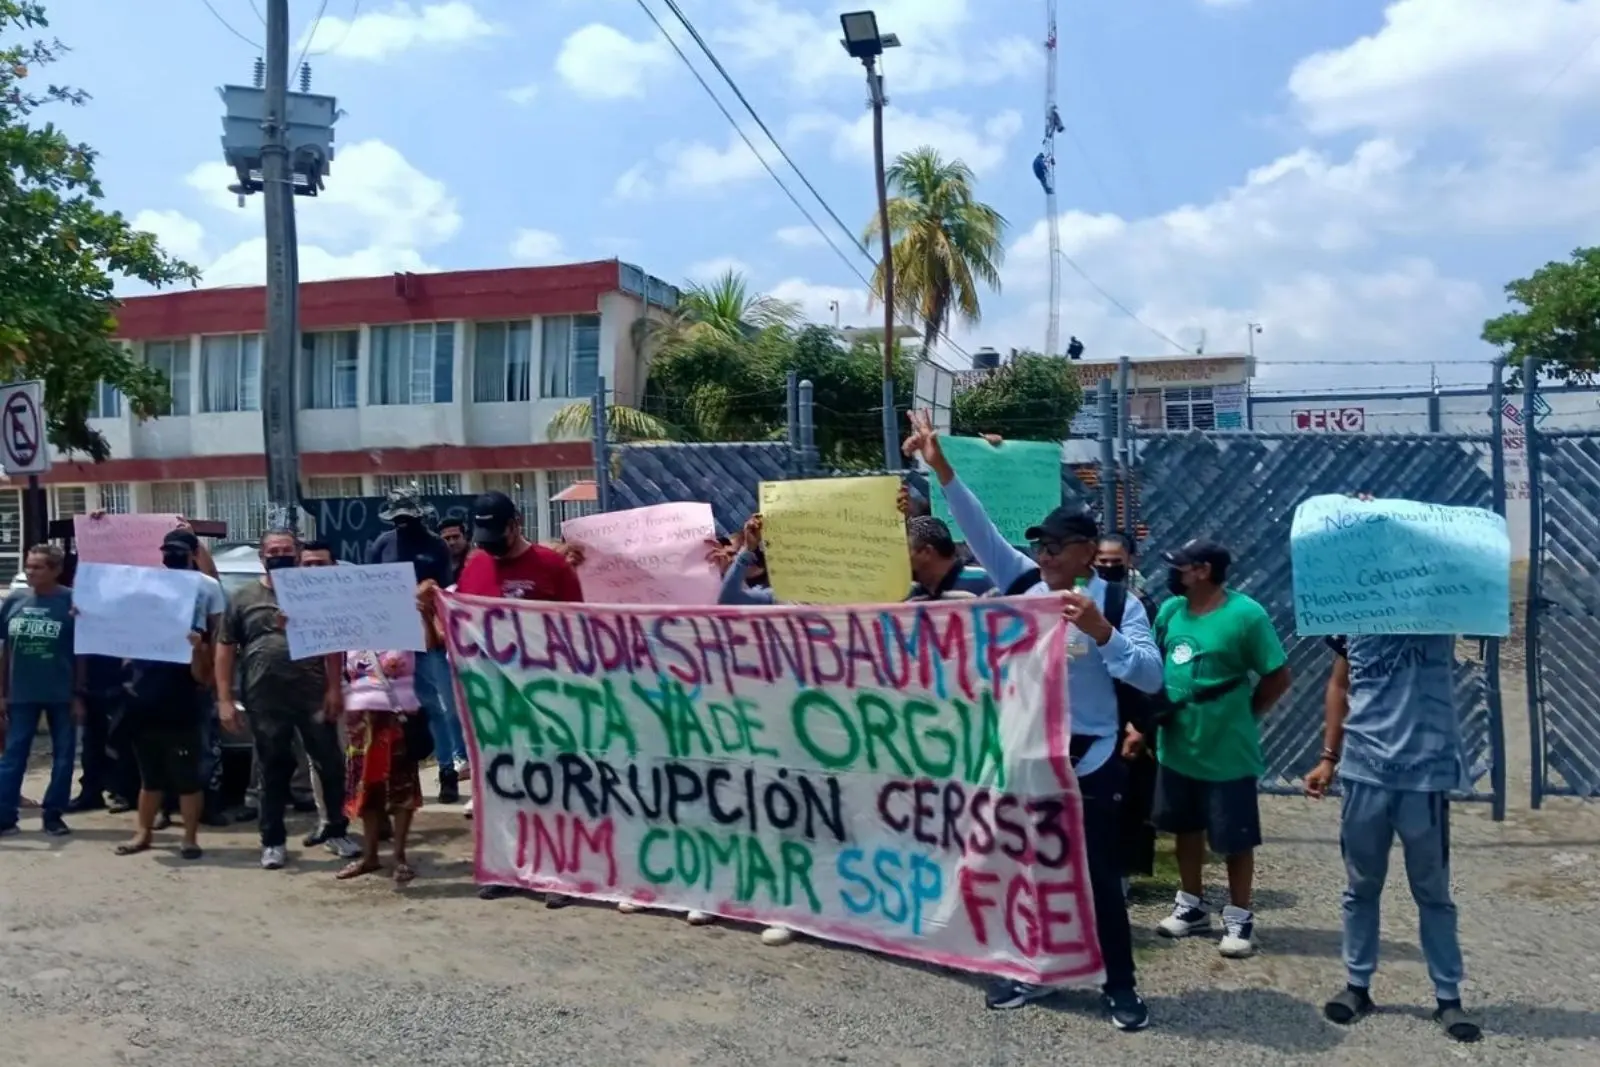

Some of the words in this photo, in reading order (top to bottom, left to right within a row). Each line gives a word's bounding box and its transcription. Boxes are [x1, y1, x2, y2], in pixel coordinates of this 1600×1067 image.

[319, 499, 368, 537] NO
[462, 668, 638, 759] BASTA
[629, 675, 719, 757] YA
[708, 695, 780, 759] DE
[791, 688, 1006, 791] ORGIA
[485, 752, 846, 843] CORRUPCIÓN
[515, 810, 618, 888] INM
[638, 827, 823, 914] COMAR
[836, 846, 942, 936] SSP
[960, 865, 1084, 958] FGE
